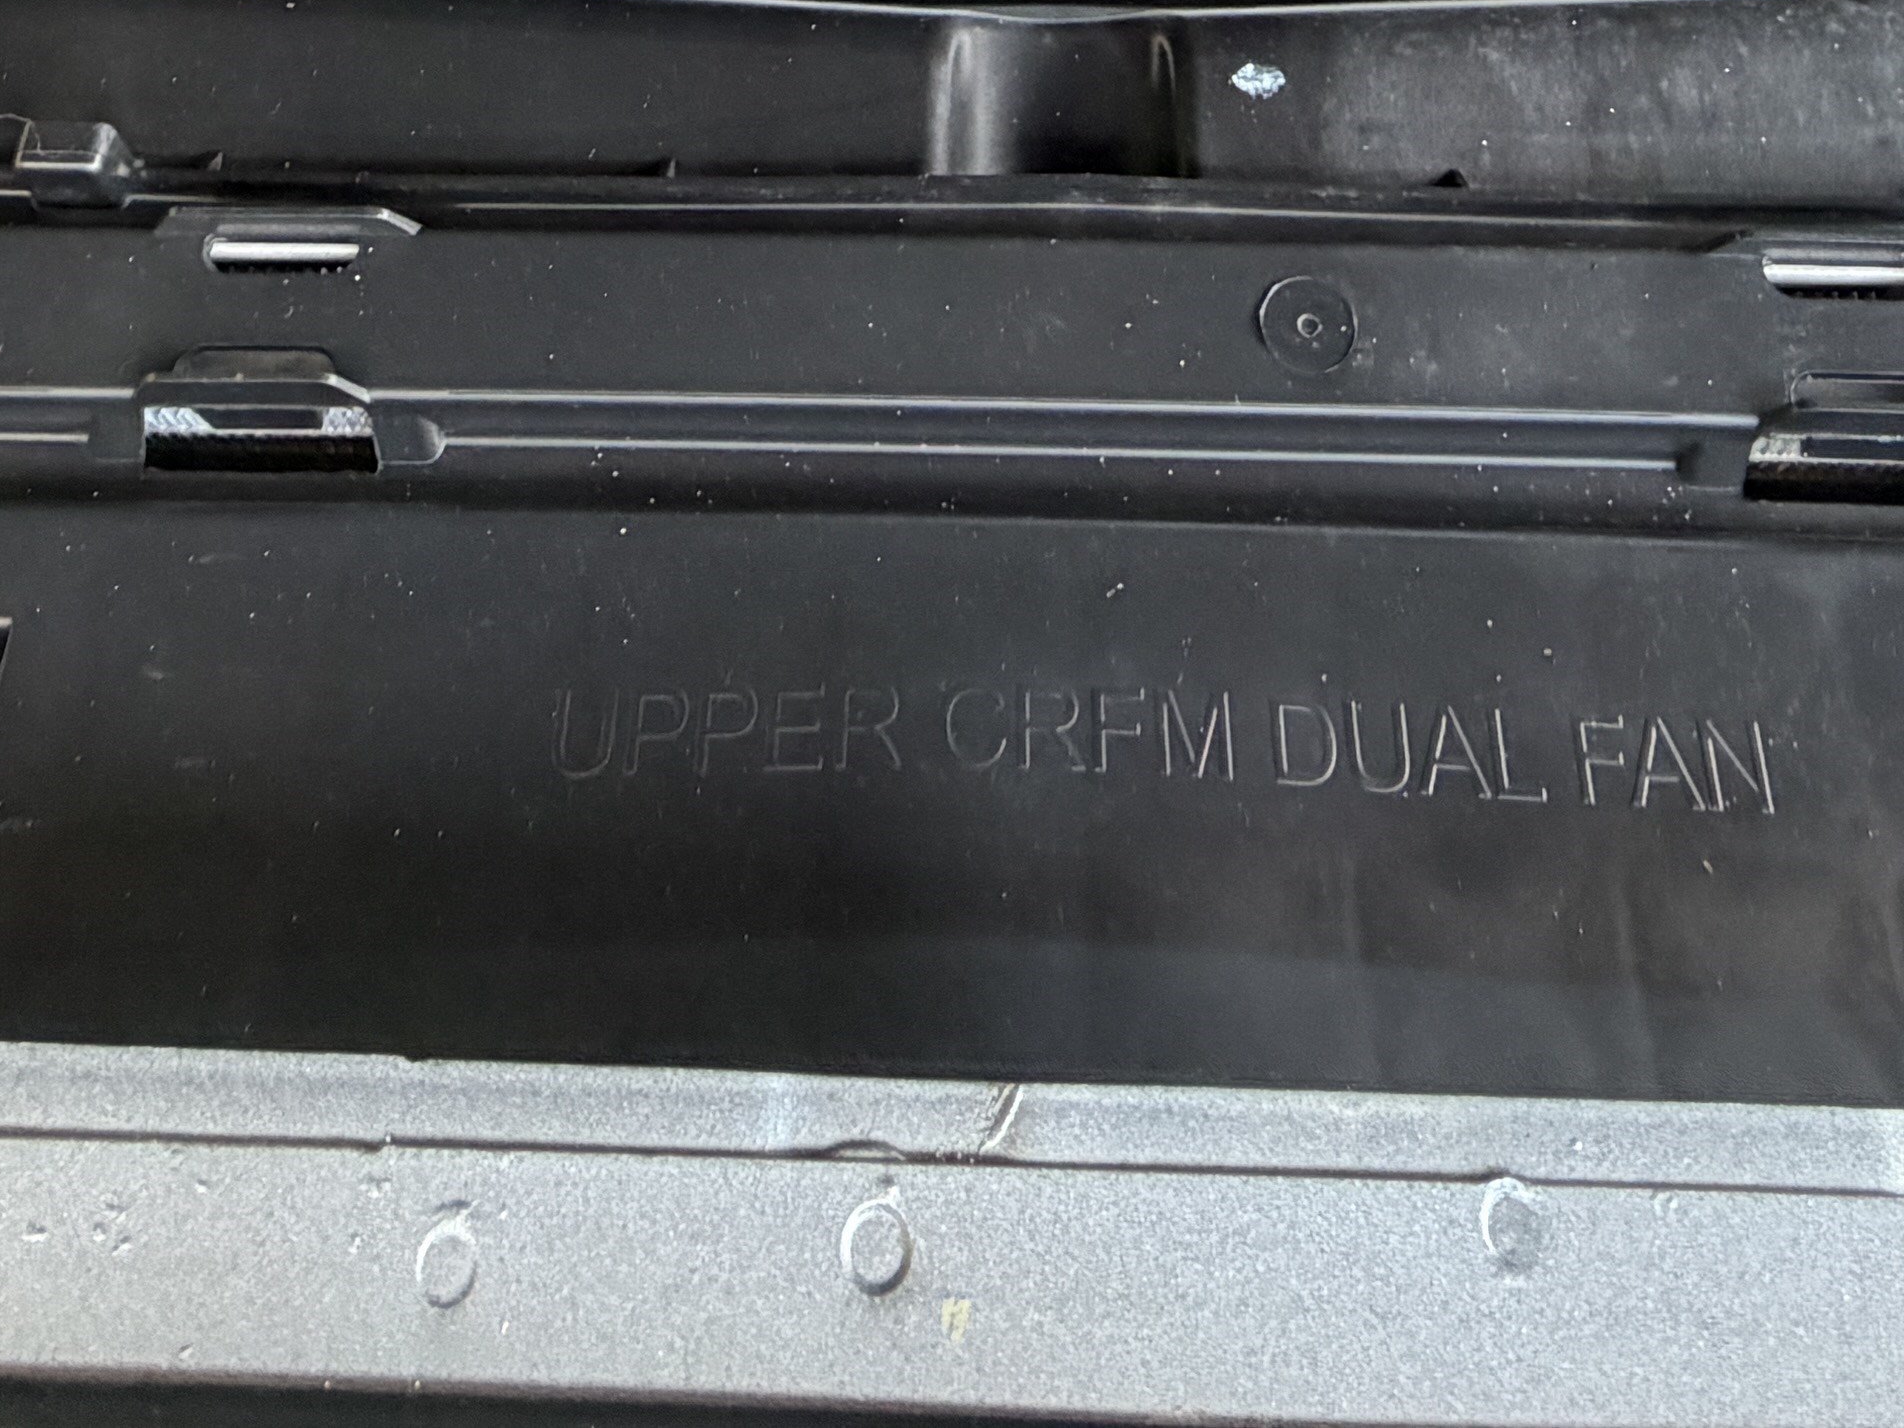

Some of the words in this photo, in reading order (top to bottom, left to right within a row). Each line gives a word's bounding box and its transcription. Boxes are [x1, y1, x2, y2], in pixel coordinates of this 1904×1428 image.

[552, 684, 902, 780] UPPER
[945, 686, 1235, 782] CRFM
[1271, 699, 1548, 804] DUAL
[1571, 713, 1776, 815] FAN
